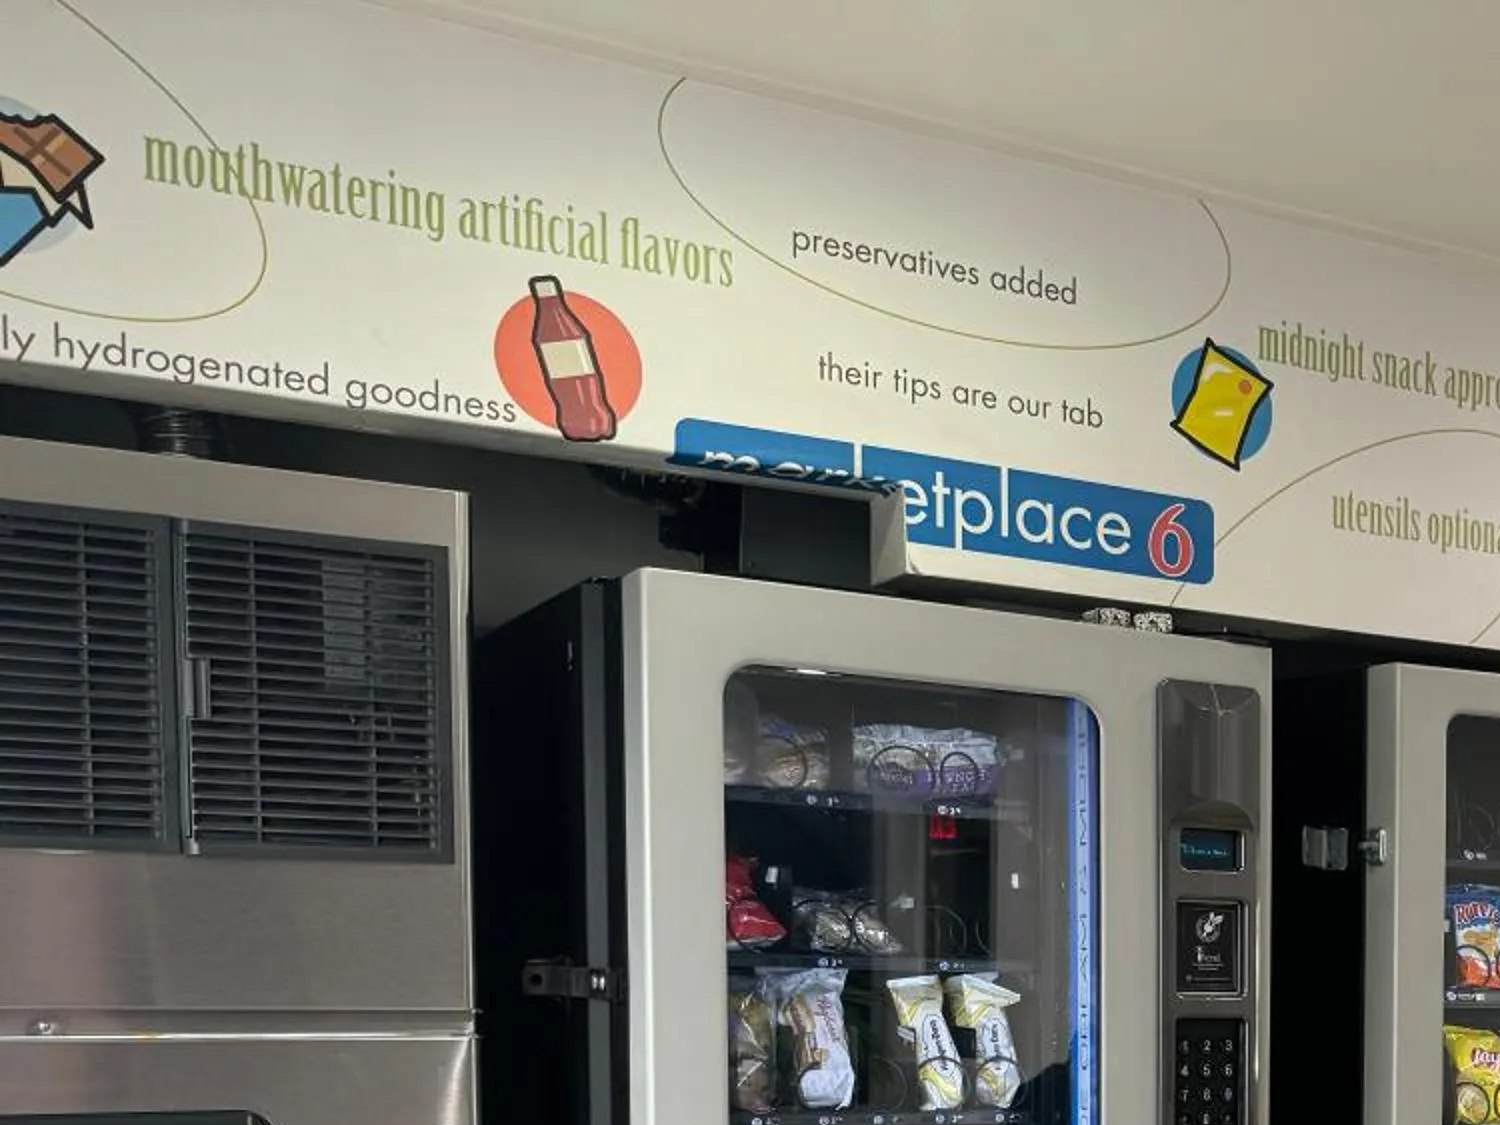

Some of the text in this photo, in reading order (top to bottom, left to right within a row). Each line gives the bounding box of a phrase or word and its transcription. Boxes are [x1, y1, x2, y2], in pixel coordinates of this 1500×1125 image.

[143, 134, 734, 288] mouthwatering artificial flavors
[792, 229, 1078, 306] preservatives added
[53, 321, 330, 396] hydrogenated
[345, 379, 517, 424] goodness
[818, 353, 1104, 430] their tips are our tab
[1258, 321, 1367, 383] midnight
[1373, 345, 1438, 398] snack
[1147, 503, 1195, 577] 6
[1332, 491, 1421, 542] utensils
